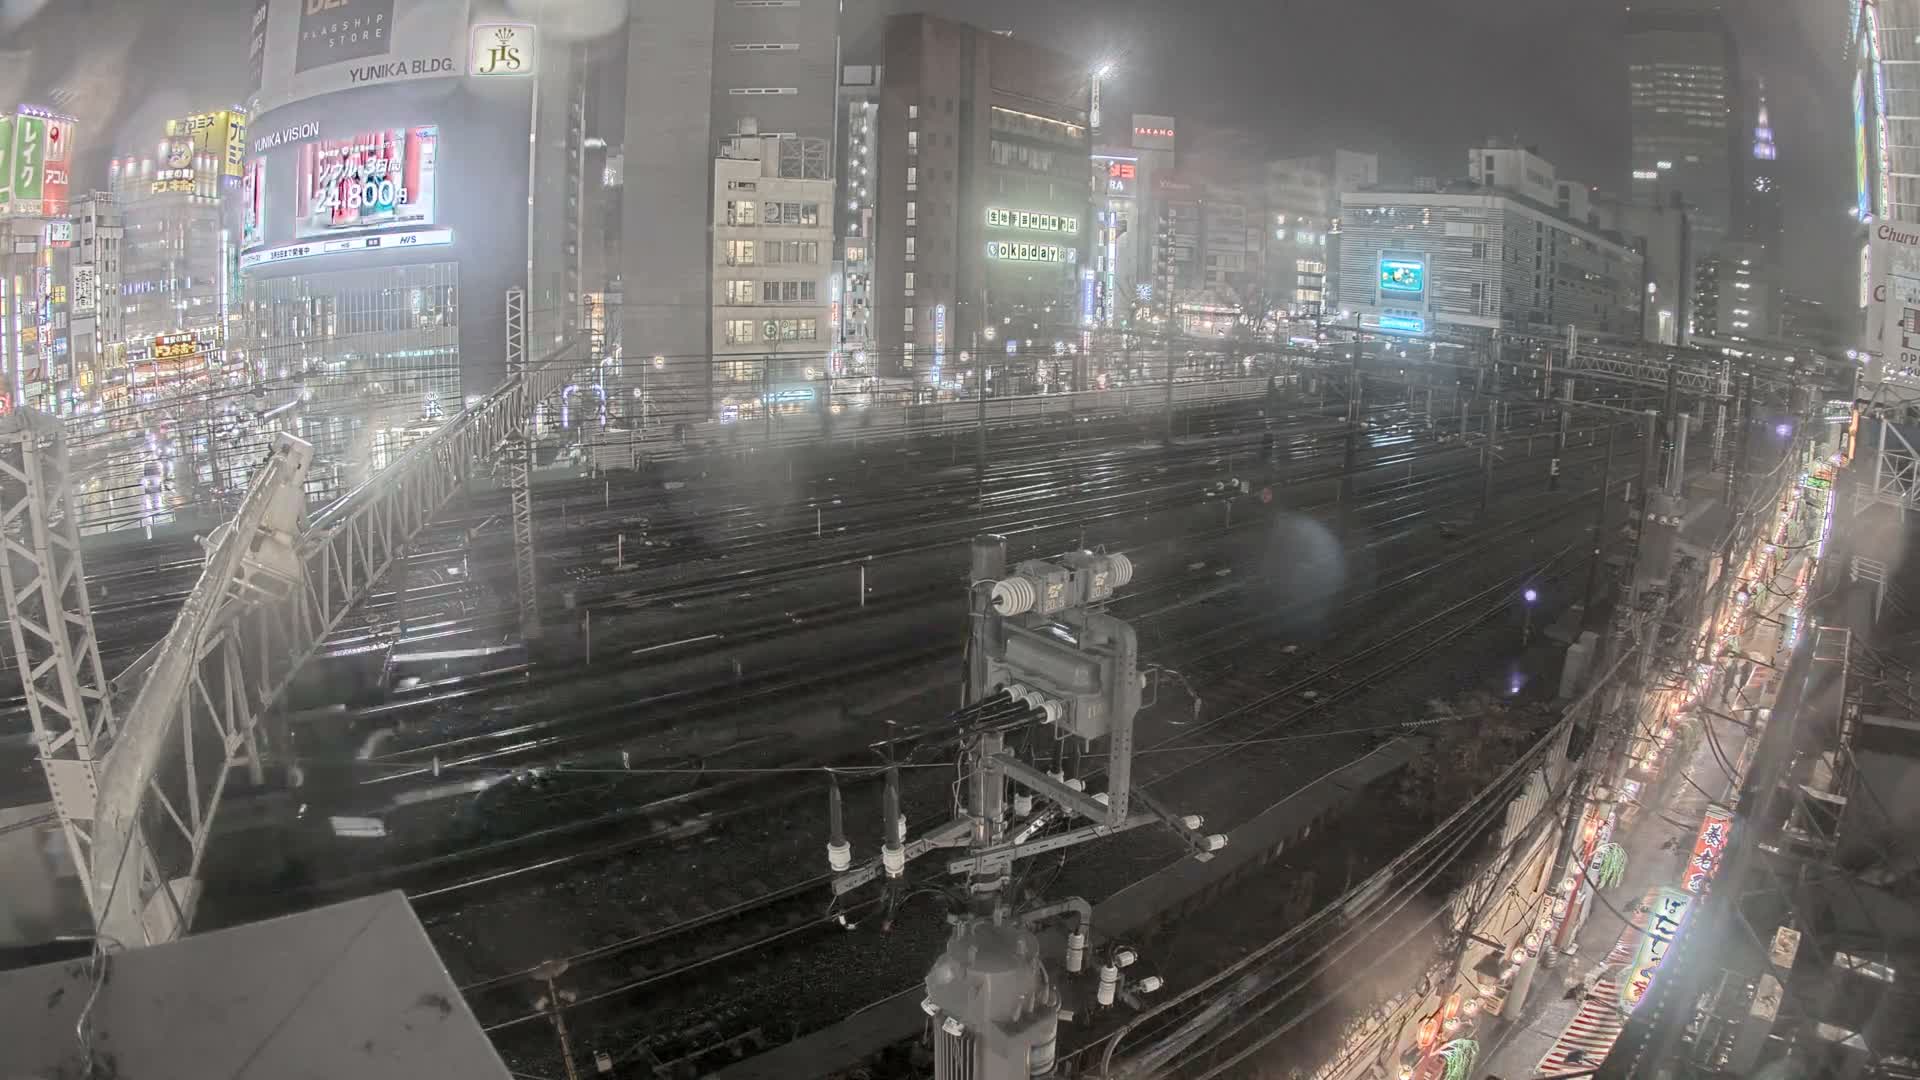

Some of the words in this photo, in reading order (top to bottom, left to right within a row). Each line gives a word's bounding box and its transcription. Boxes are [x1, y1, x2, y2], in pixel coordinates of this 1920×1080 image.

[303, 14, 383, 40] FLAGSHIP
[329, 28, 382, 47] STORE
[350, 60, 408, 82] YUNIKA
[411, 58, 456, 74] BLDG.
[254, 132, 281, 152] YUNIKA
[283, 121, 319, 143] VISION
[1135, 127, 1174, 137] TAKANO
[21, 121, 37, 188] レイク
[45, 169, 68, 185] アコム
[1000, 243, 1065, 261] okadaya
